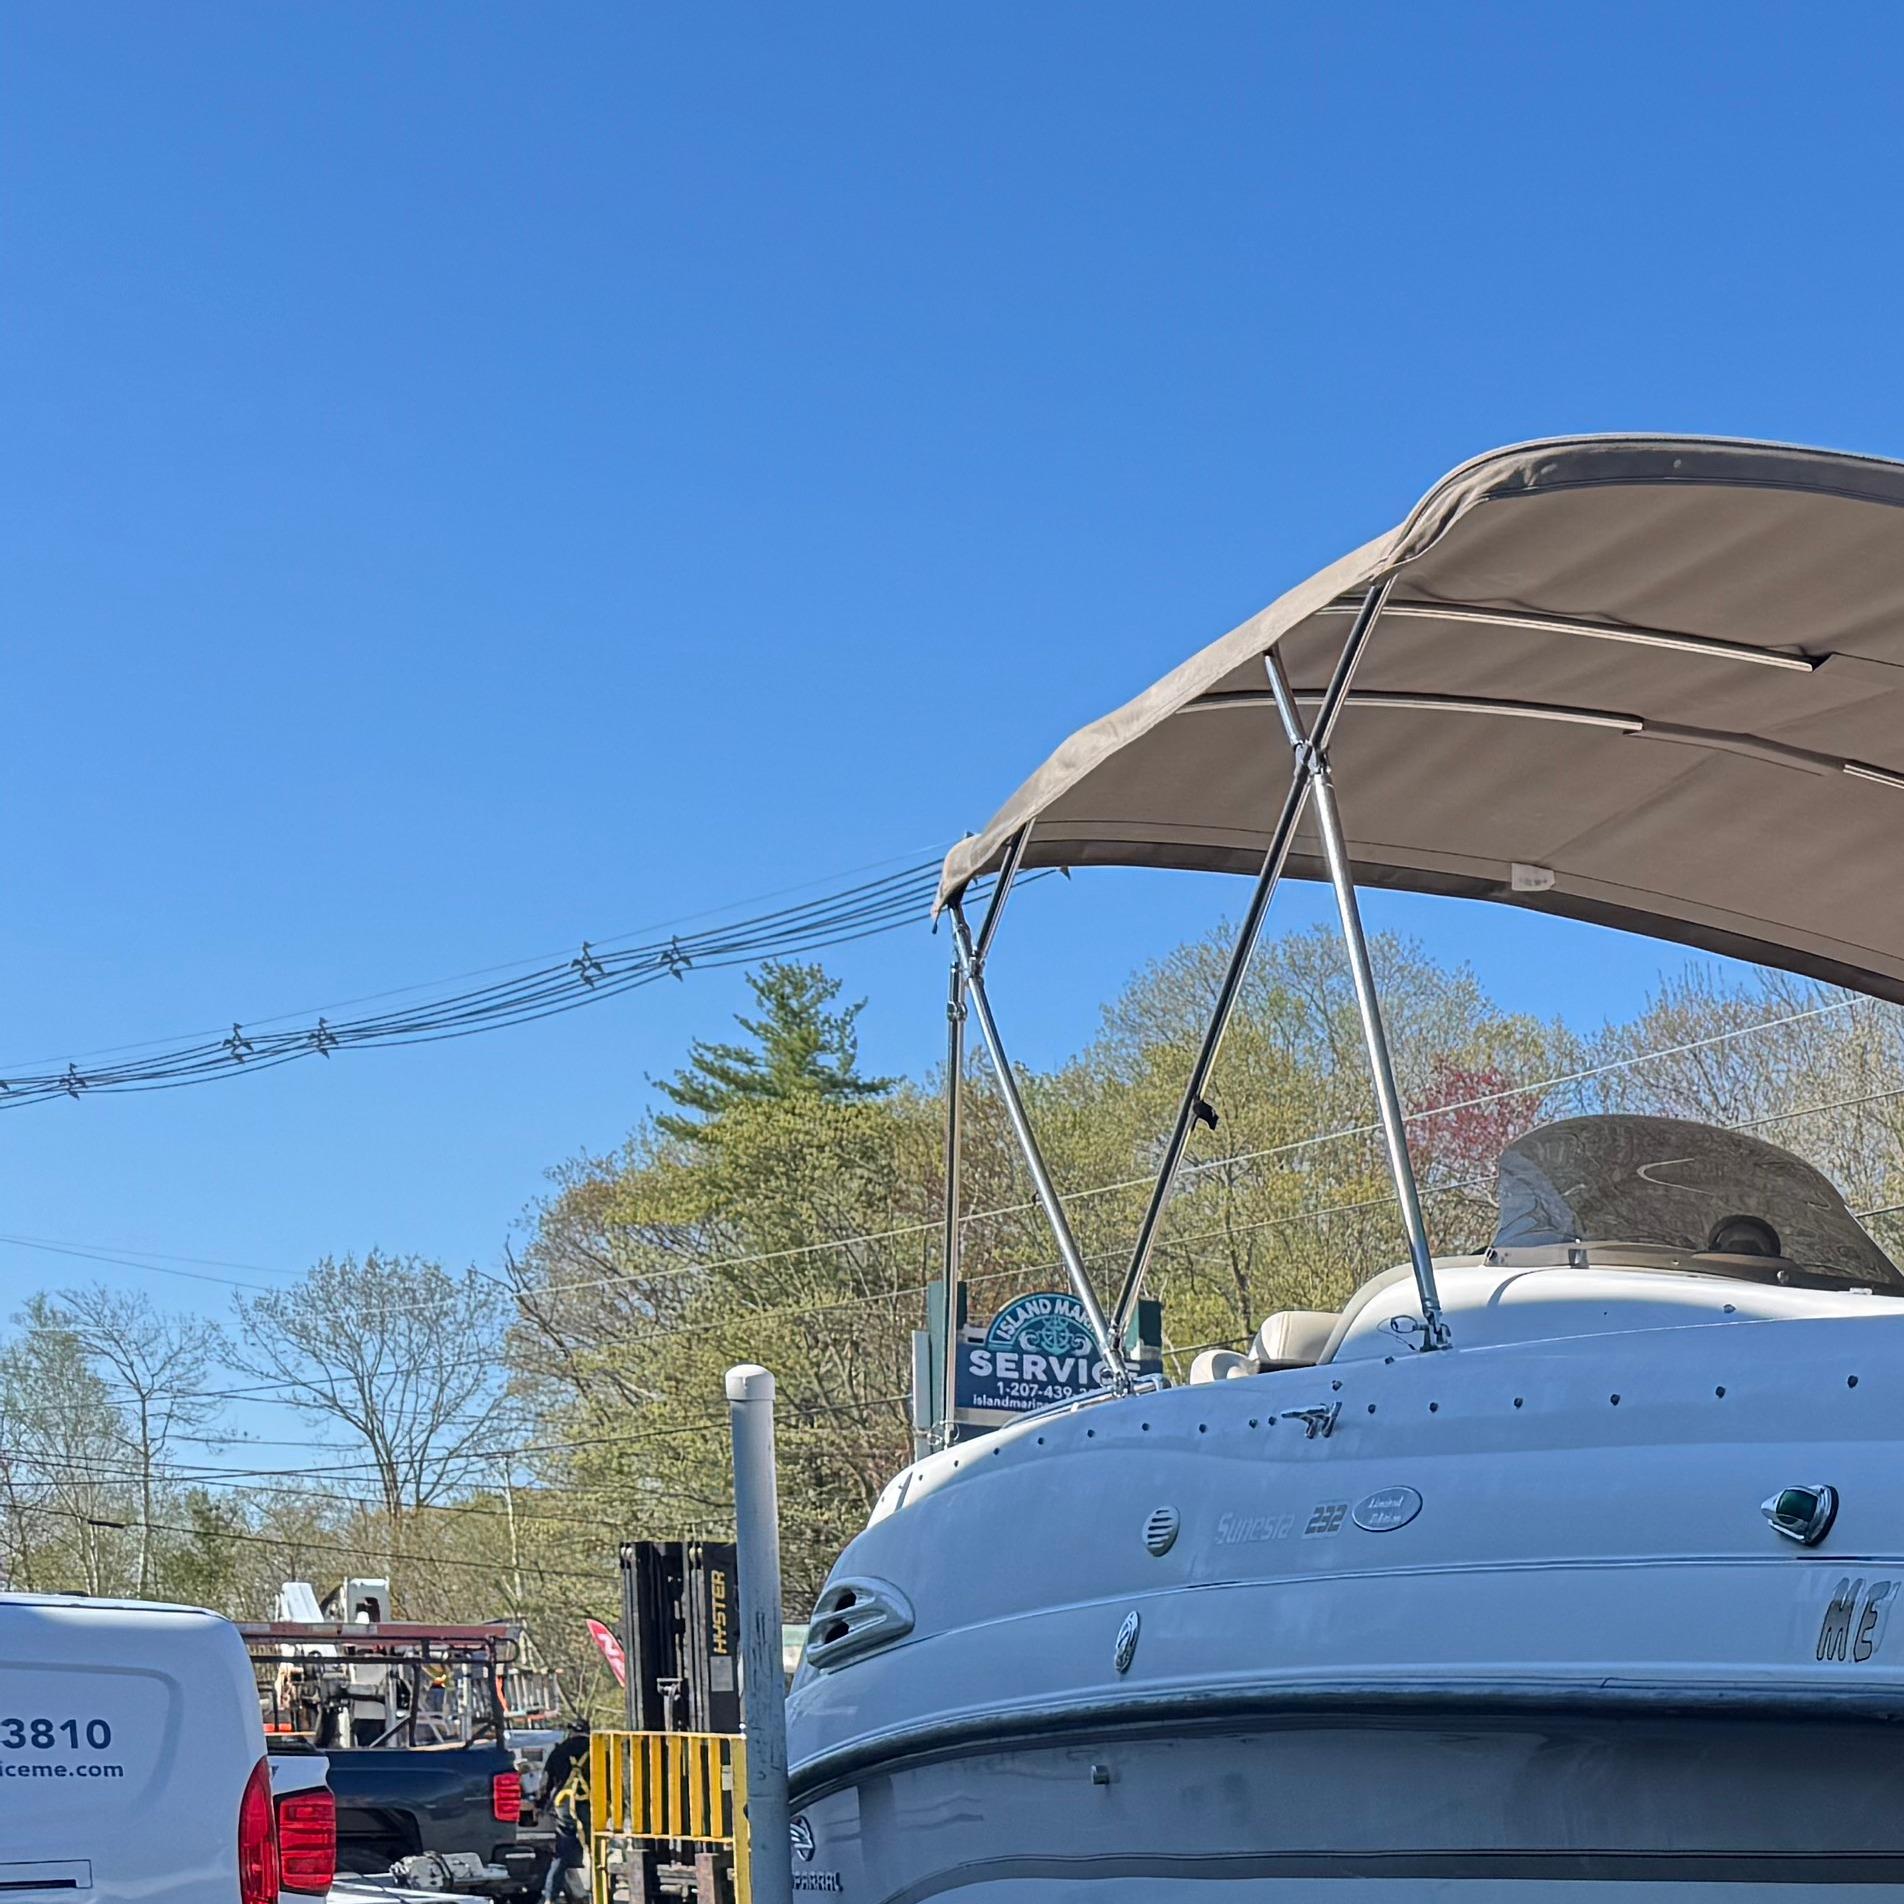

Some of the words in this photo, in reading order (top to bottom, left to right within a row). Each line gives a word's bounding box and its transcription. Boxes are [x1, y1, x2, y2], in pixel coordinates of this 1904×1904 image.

[996, 1298, 1052, 1340] ISLAND
[1303, 1502, 1348, 1535] 232
[711, 1569, 728, 1655] HYSTER
[1816, 1577, 1892, 1663] ME
[0, 1718, 112, 1750] 3810
